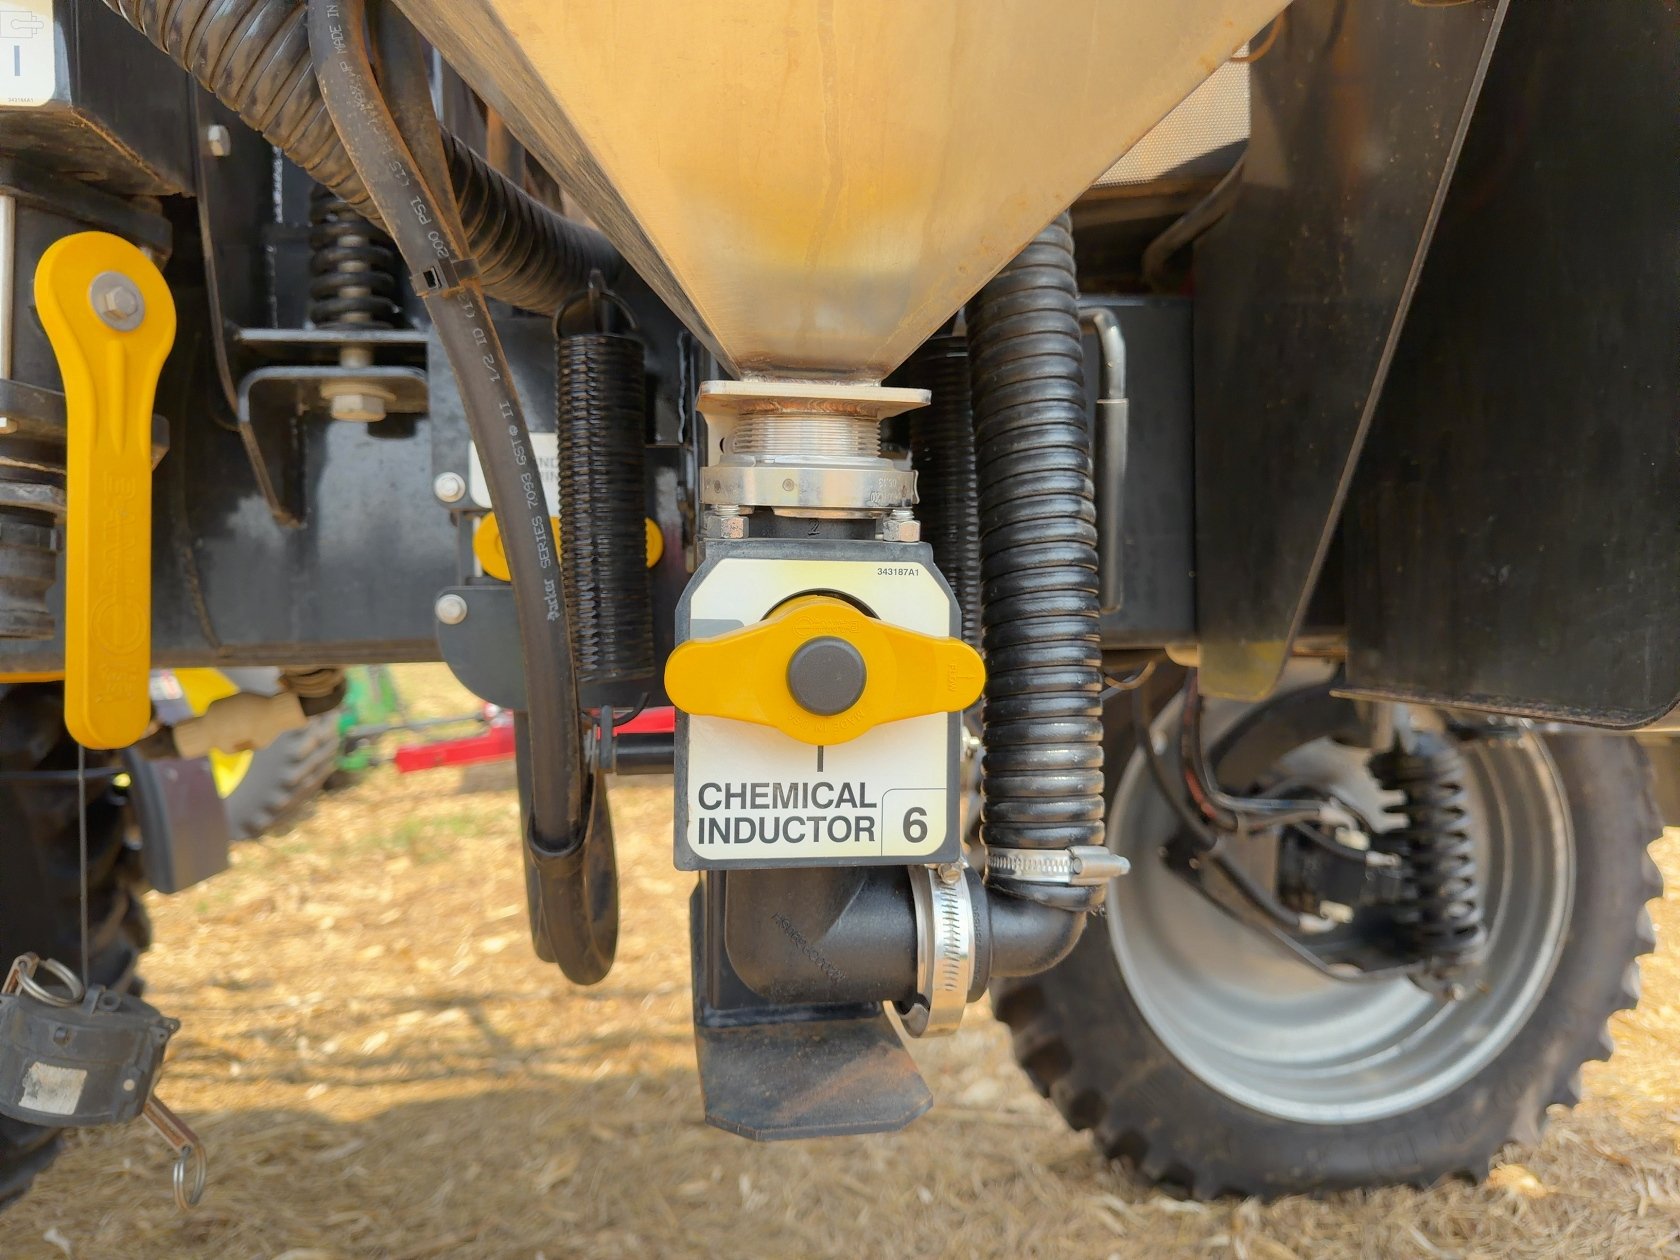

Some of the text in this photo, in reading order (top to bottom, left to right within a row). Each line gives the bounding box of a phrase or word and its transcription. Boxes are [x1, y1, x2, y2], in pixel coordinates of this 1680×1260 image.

[327, 5, 340, 18] IN
[329, 25, 348, 54] MADE
[411, 196, 433, 225] PSI
[428, 231, 449, 259] 200
[472, 327, 487, 346] ID
[483, 354, 500, 382] 1/2
[521, 473, 538, 509] 7093
[531, 516, 552, 568] SERIES
[877, 568, 919, 576] 343187A1
[698, 782, 877, 811] CHEMICAL
[698, 815, 875, 845] INDUCTOR
[903, 806, 928, 843] 6
